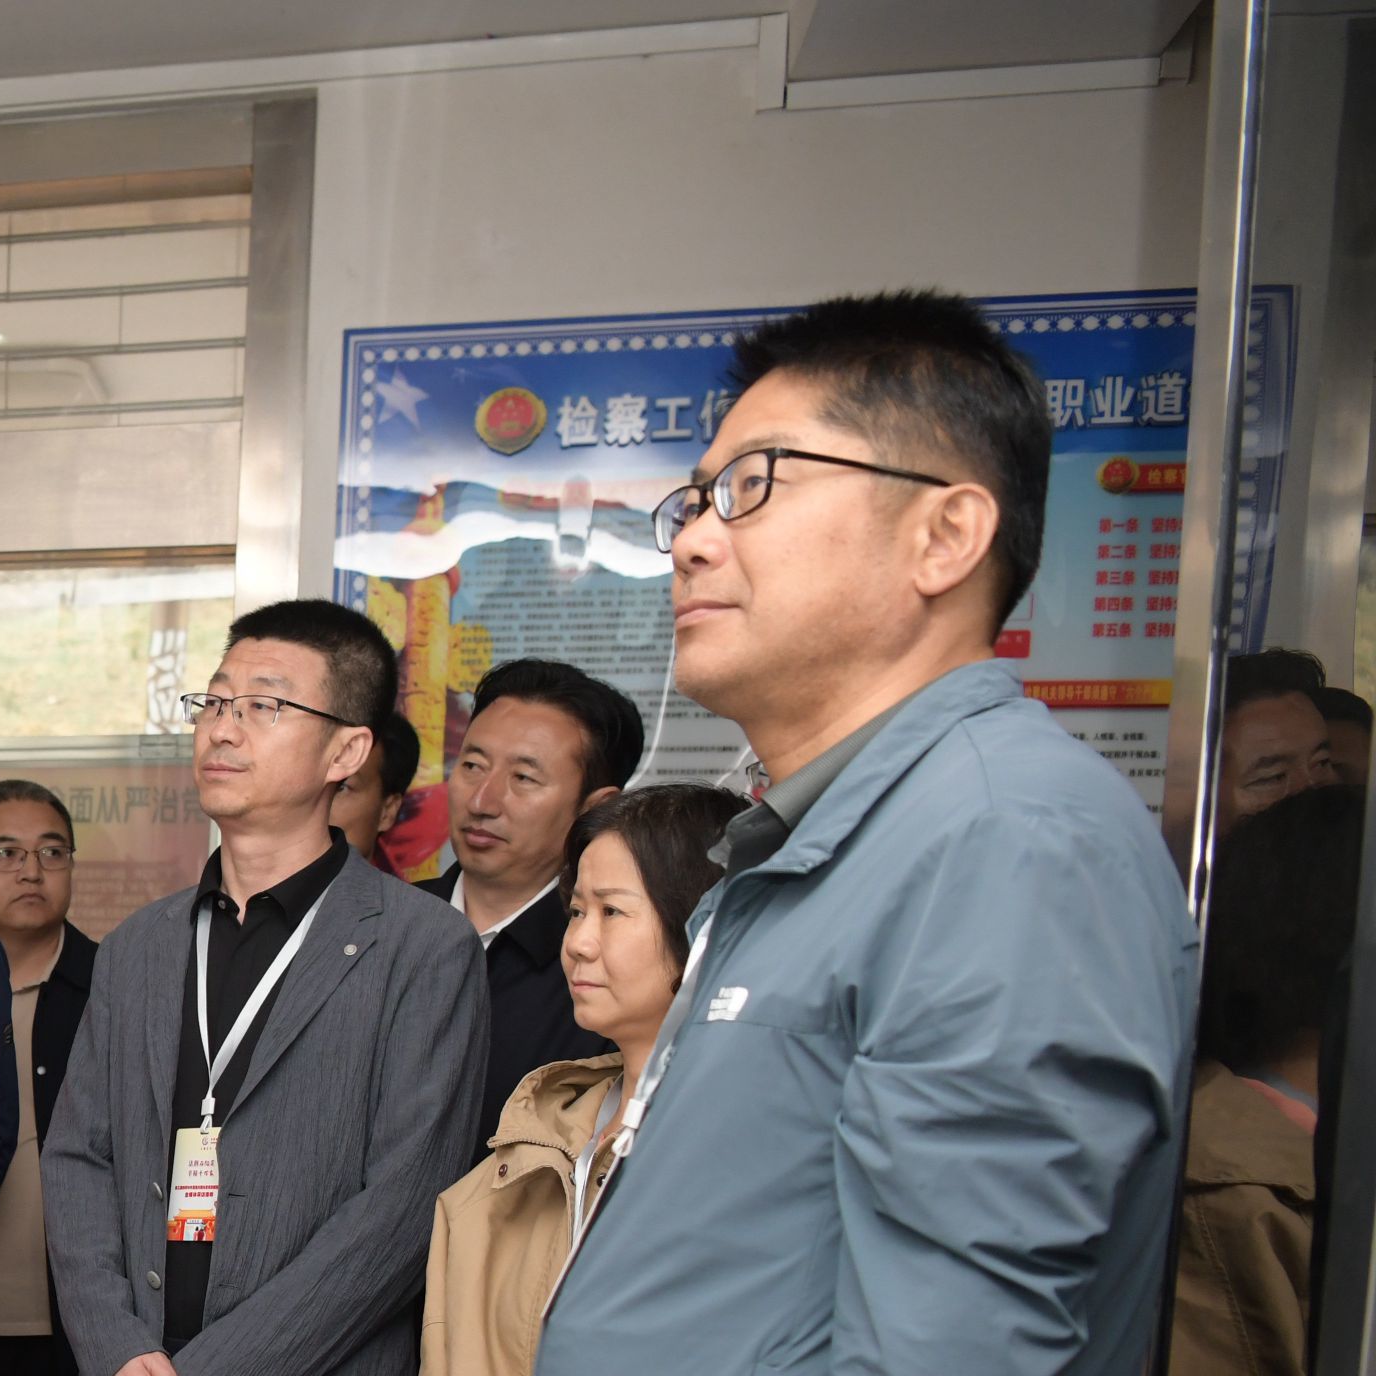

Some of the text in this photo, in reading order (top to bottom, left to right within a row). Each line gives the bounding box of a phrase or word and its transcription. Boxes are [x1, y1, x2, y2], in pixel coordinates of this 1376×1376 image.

[1099, 516, 1183, 533] 第一条 坚持
[1097, 543, 1180, 560] 第二条 坚持
[1096, 569, 1179, 586] 第三条 坚持
[1094, 595, 1178, 612] 第四条 坚持
[1092, 621, 1176, 638] 第五条 坚持
